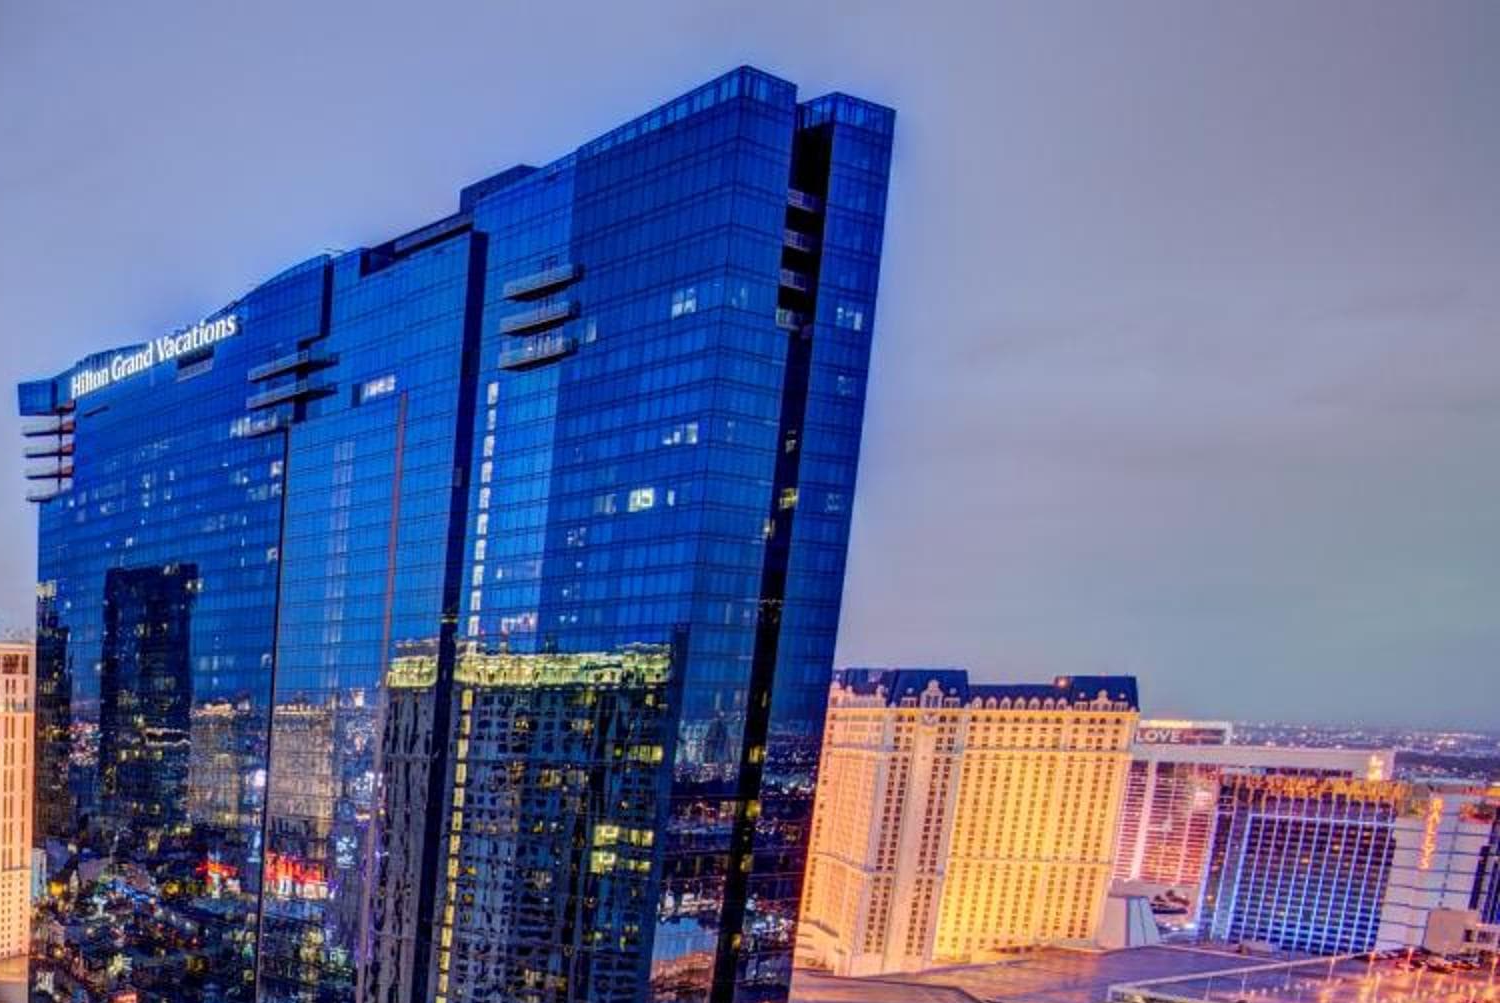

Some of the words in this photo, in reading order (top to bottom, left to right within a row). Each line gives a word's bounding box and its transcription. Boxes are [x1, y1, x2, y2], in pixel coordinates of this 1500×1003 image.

[71, 366, 109, 399] Hilton
[111, 342, 154, 381] Grand
[156, 314, 238, 362] Vacations
[1134, 729, 1181, 744] LOVE
